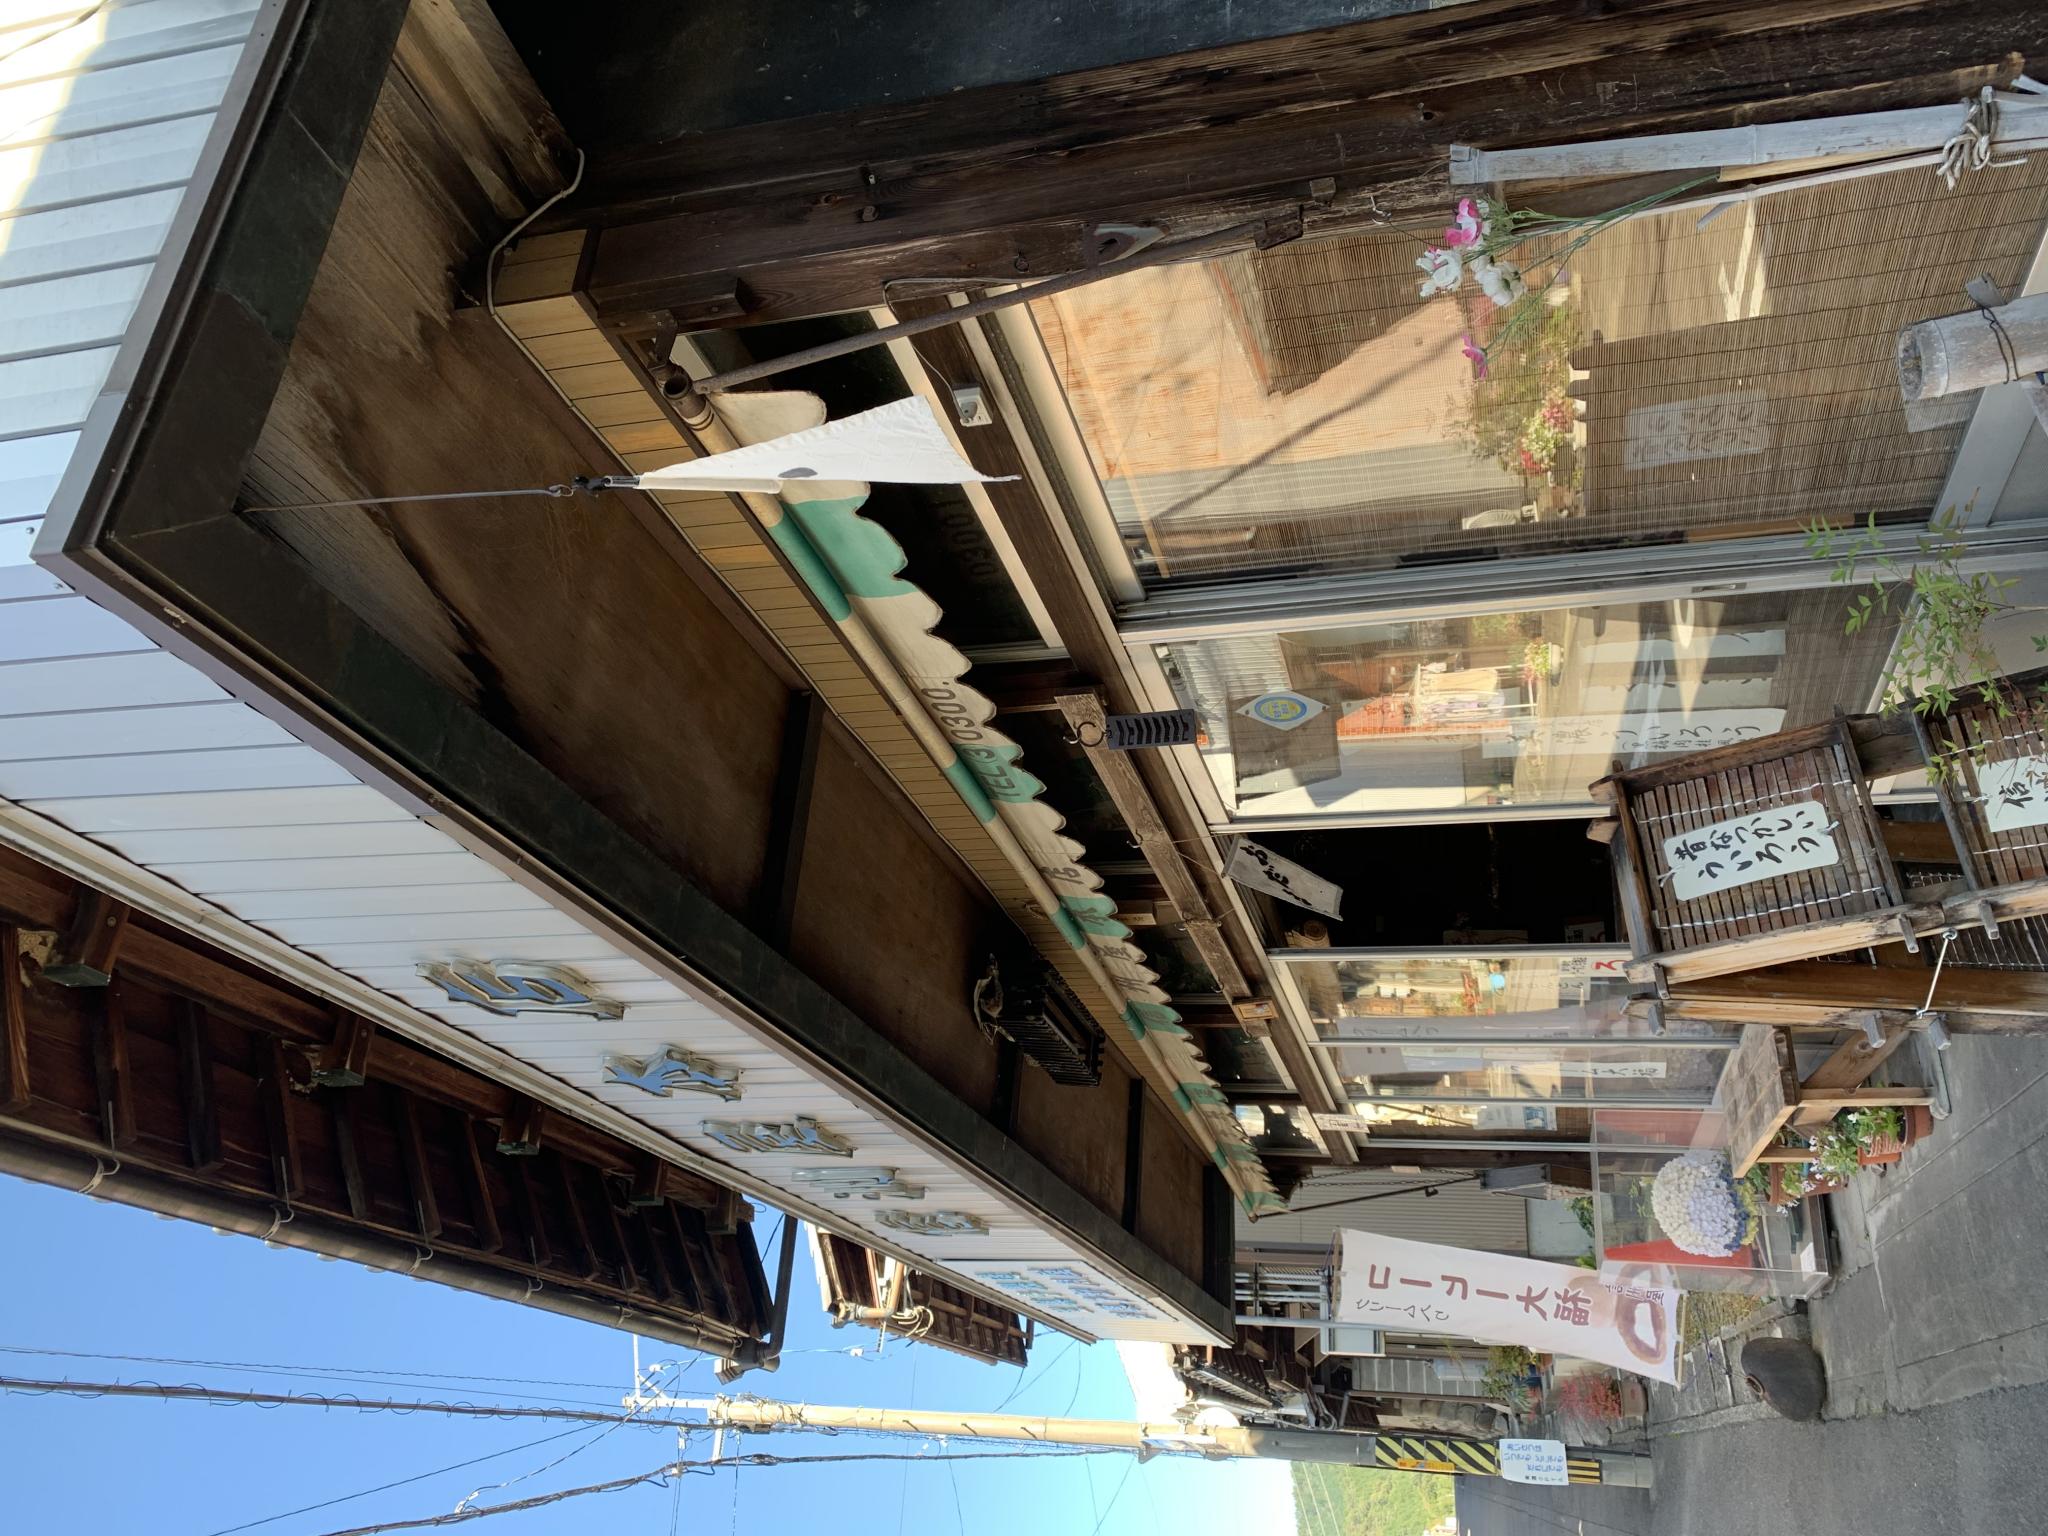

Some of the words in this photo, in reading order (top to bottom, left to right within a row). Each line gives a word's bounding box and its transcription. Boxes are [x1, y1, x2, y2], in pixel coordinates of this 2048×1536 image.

[978, 766, 1021, 798] TEL
[1674, 811, 1814, 862] 昔なつかしい
[1697, 836, 1820, 879] ういろう
